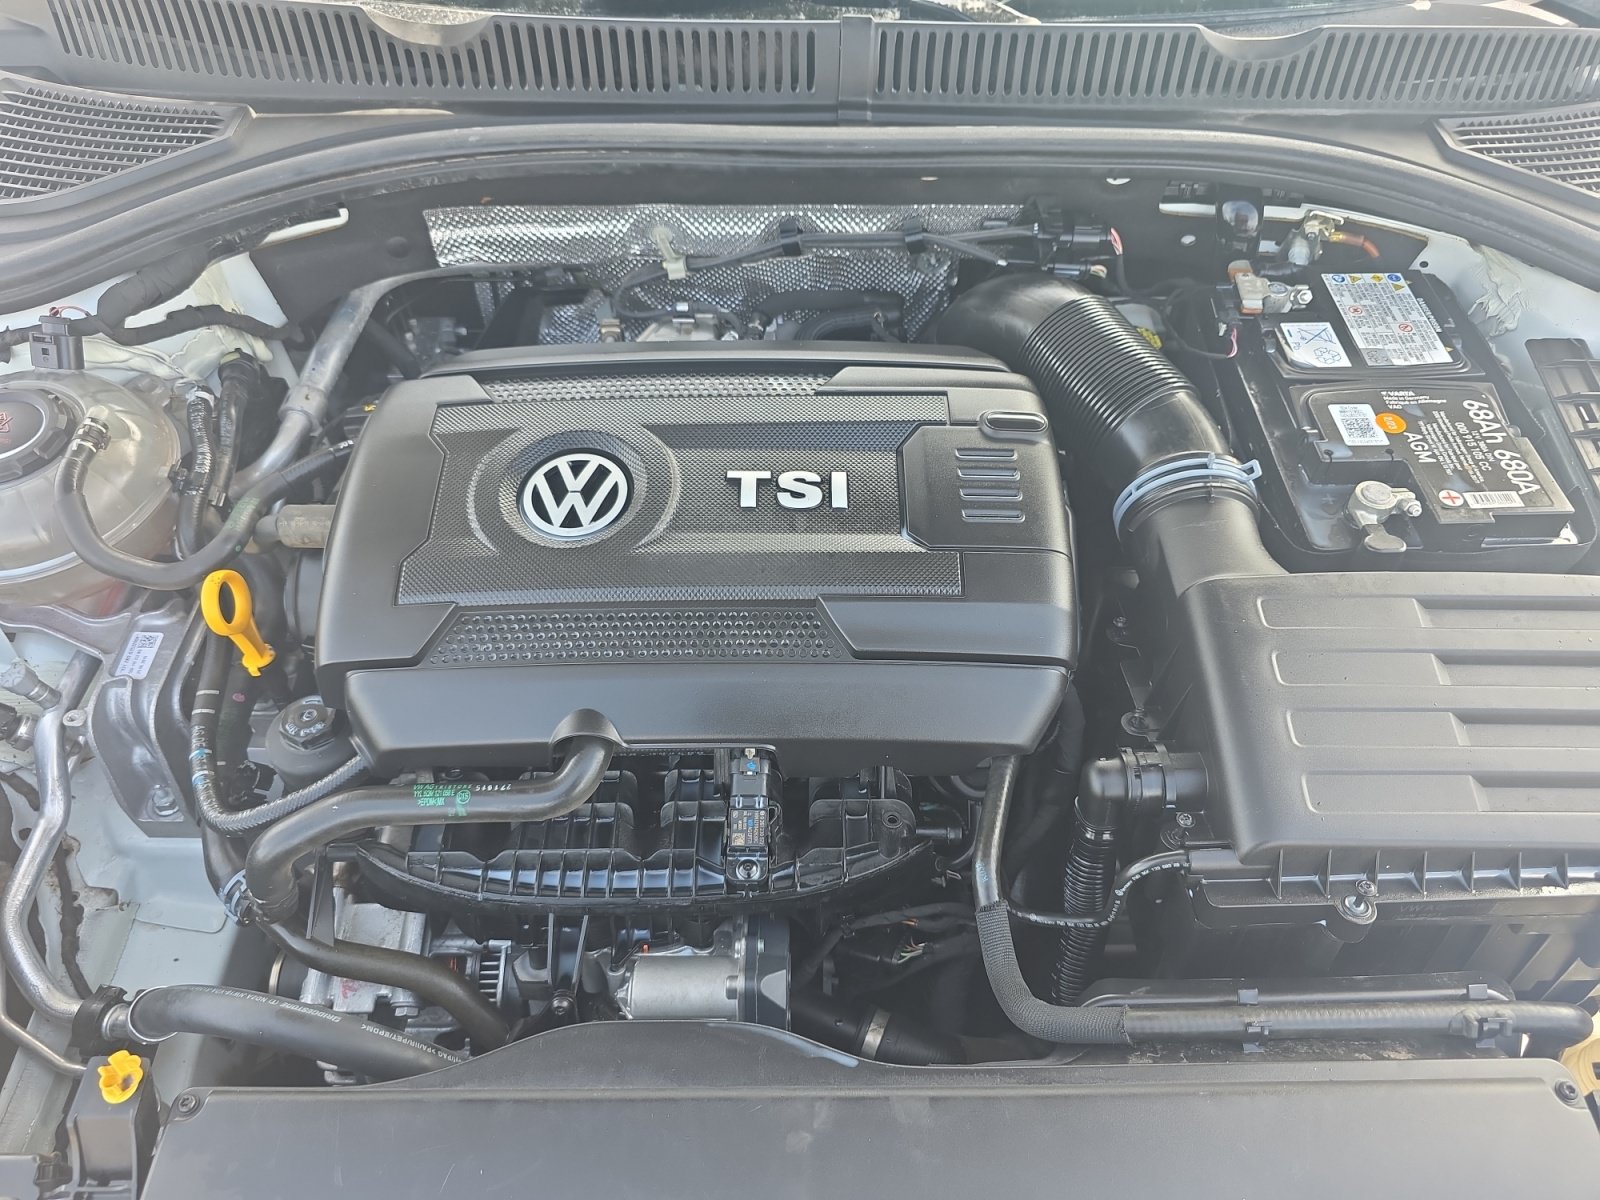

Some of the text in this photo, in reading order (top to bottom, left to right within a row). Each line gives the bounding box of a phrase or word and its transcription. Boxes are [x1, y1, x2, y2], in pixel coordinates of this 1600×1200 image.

[1404, 432, 1436, 462] AGM
[1463, 400, 1540, 494] 68Ah 680A
[1463, 435, 1477, 447] 915
[1471, 448, 1485, 460] 105
[1479, 461, 1492, 471] CC
[727, 470, 848, 510] TSI
[279, 1000, 342, 1023] BRIDGESTONE
